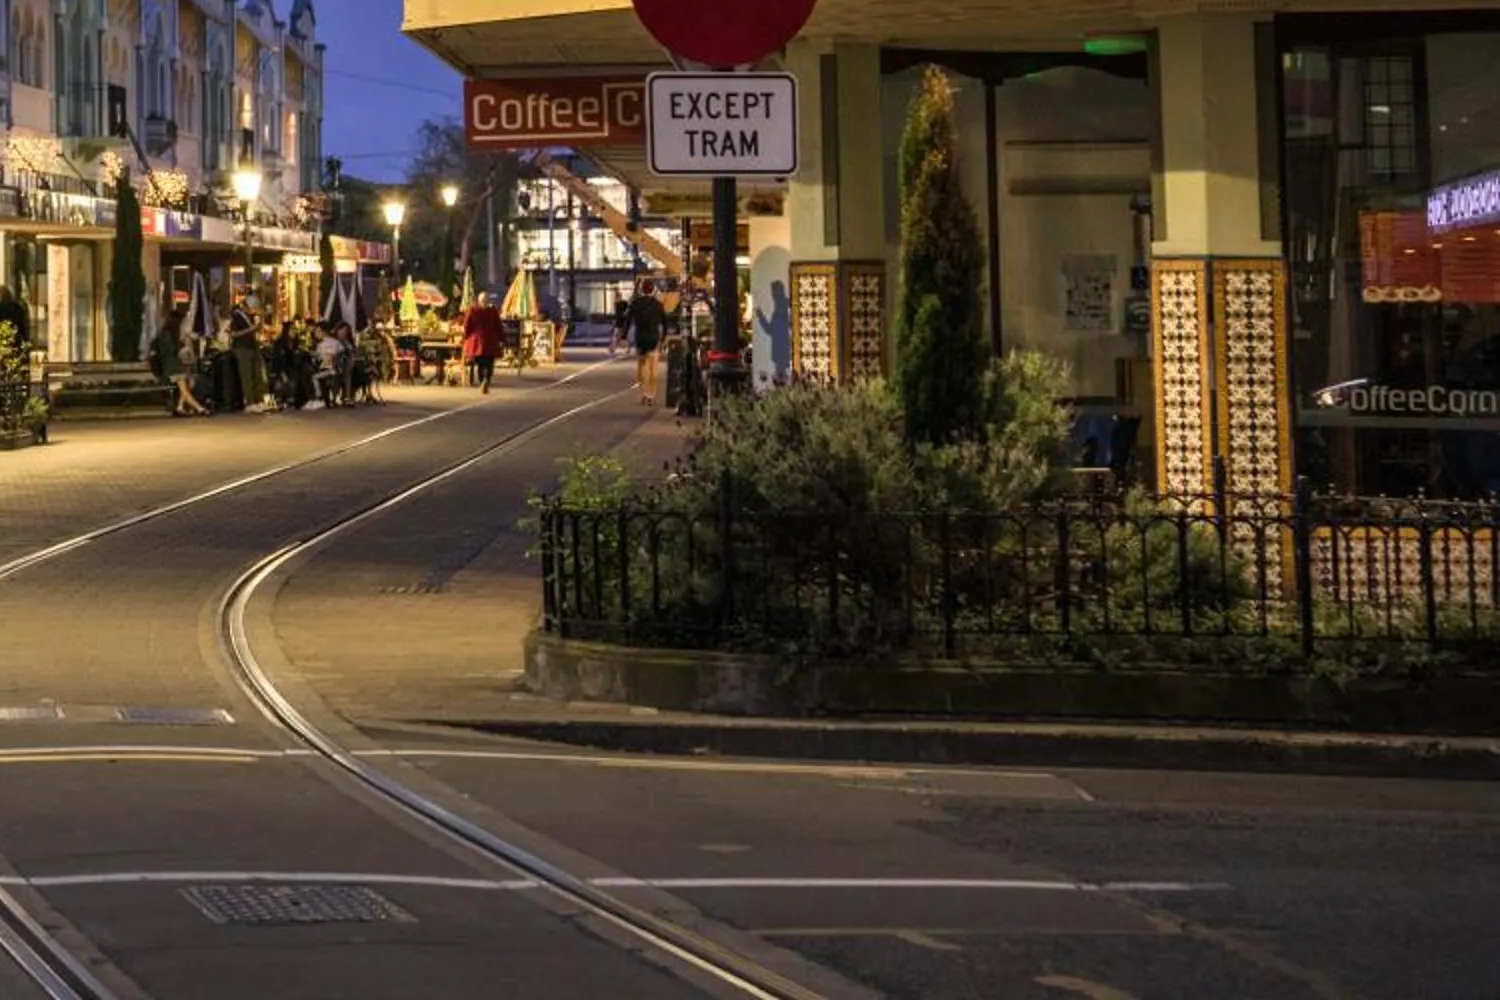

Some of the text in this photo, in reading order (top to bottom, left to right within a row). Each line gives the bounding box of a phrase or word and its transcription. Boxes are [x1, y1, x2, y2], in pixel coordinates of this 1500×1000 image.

[472, 93, 600, 131] Coffee
[669, 91, 775, 119] EXCEPT
[685, 130, 760, 158] TRAM
